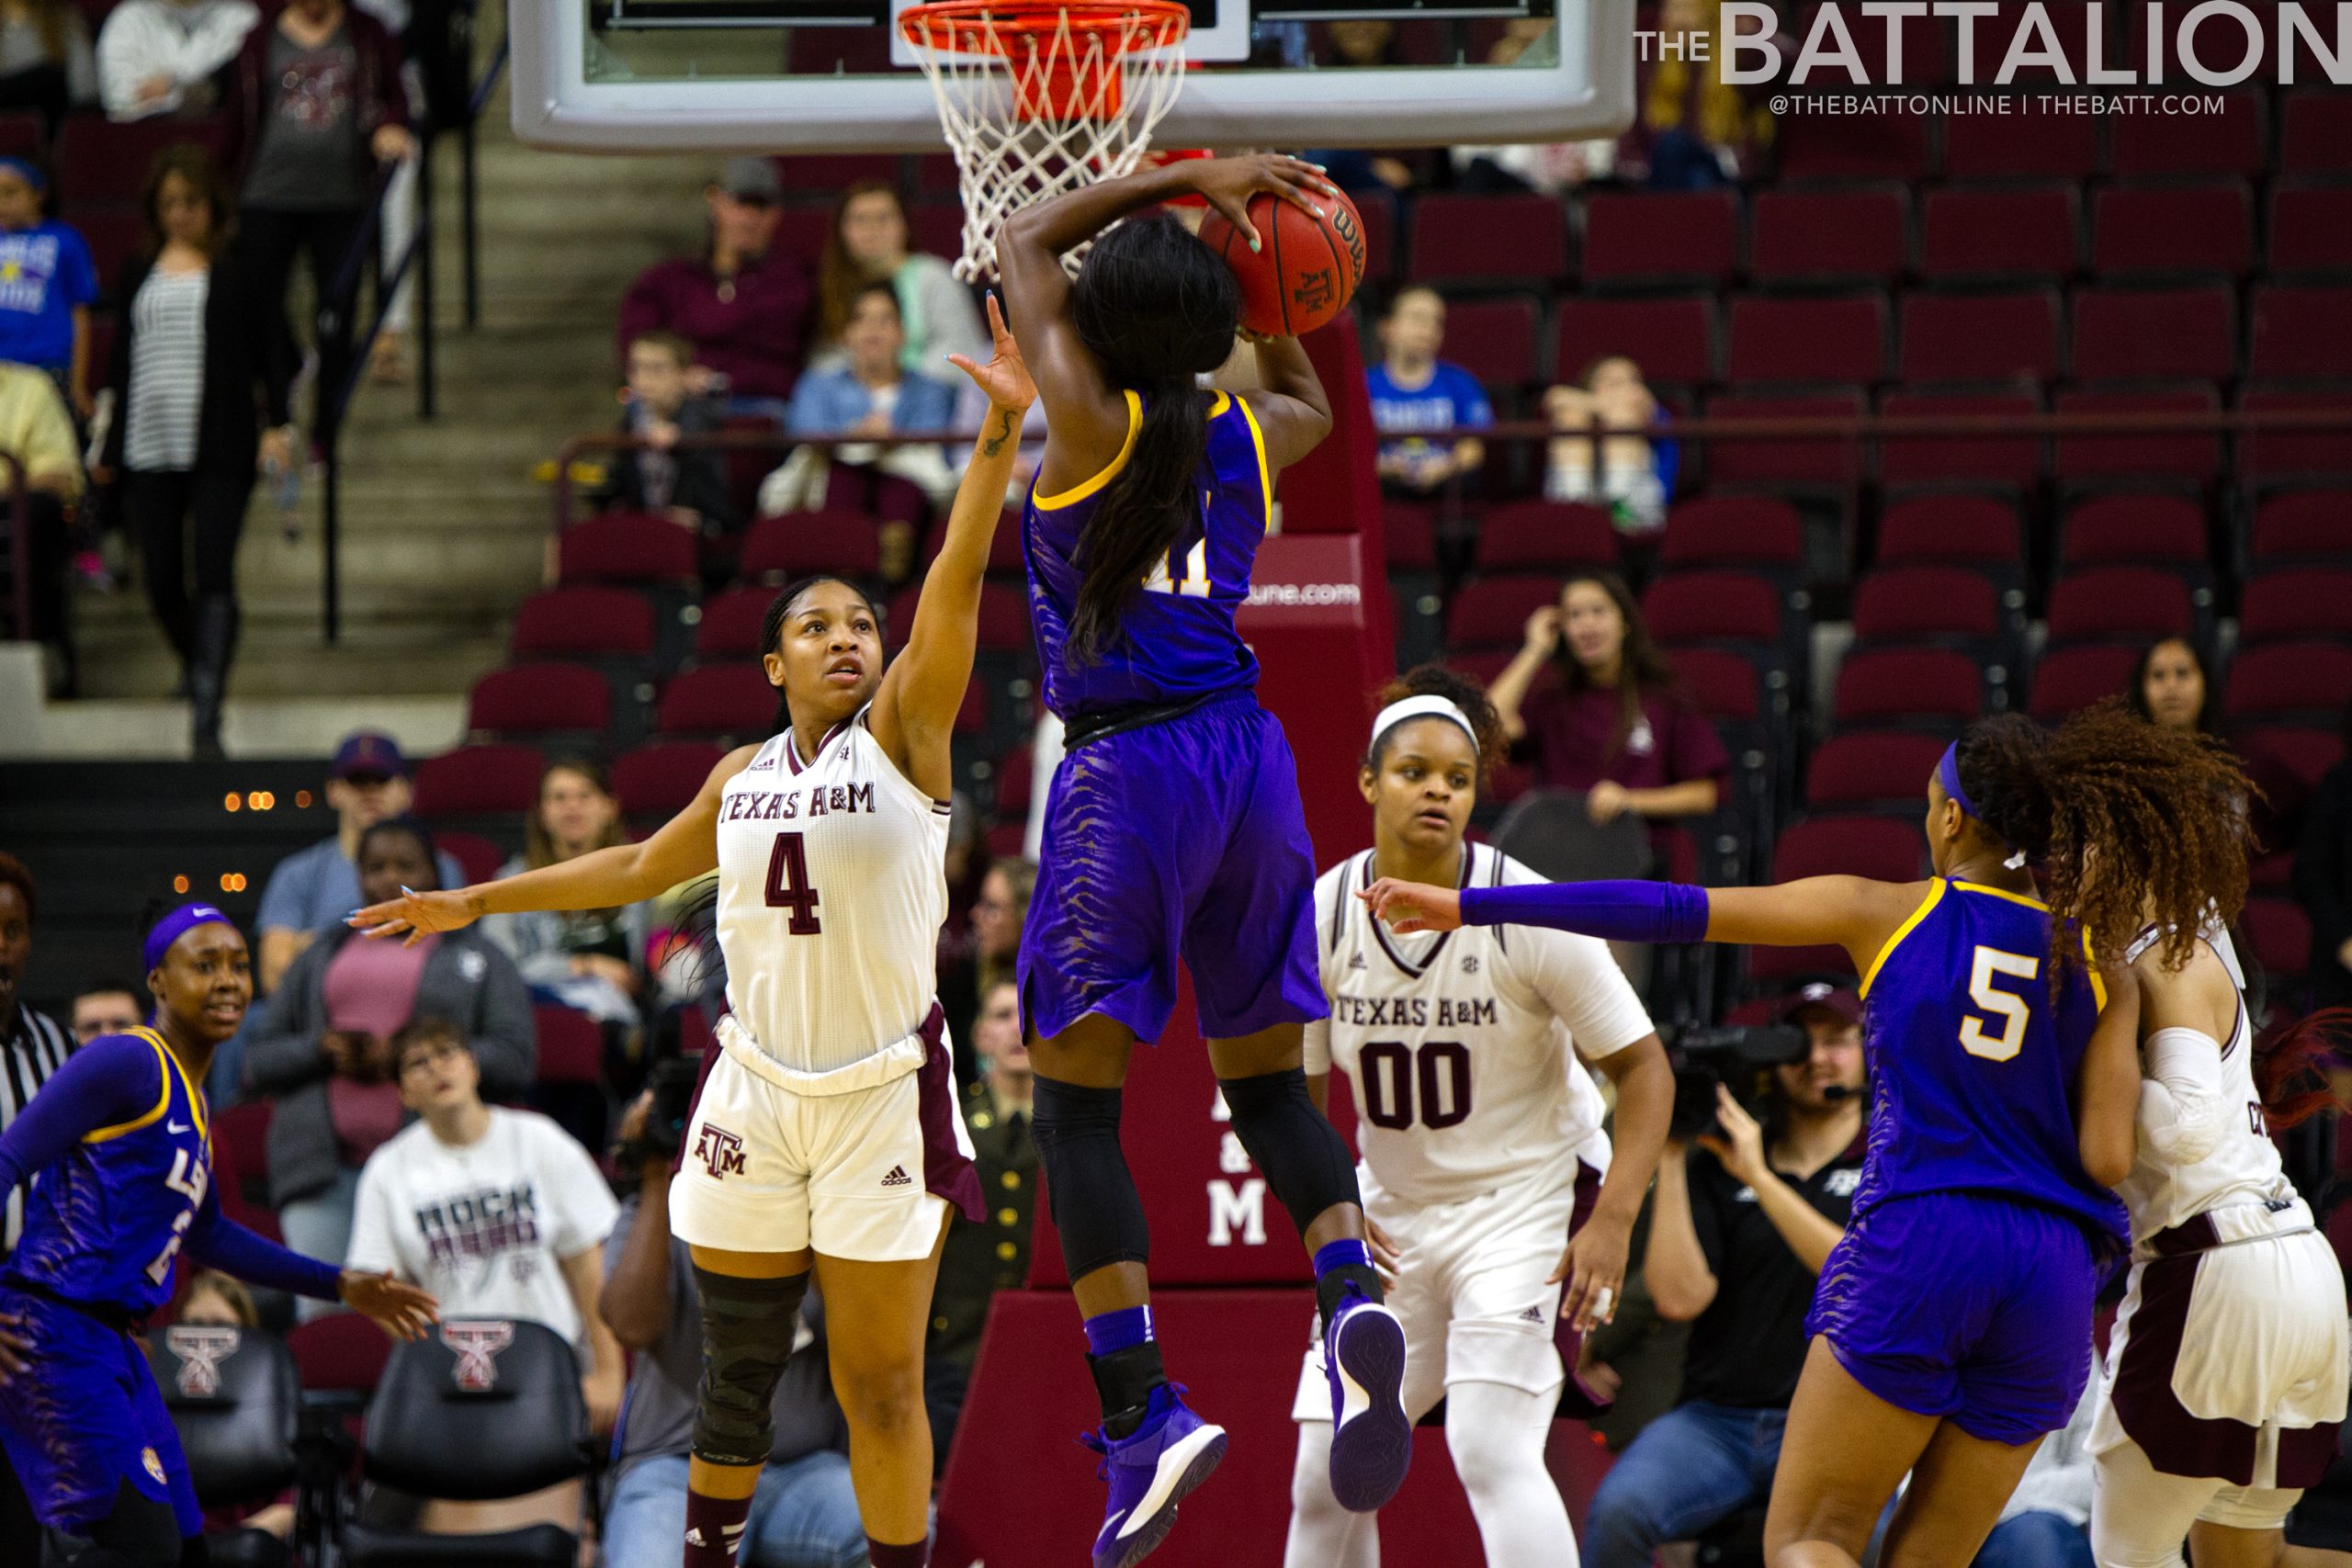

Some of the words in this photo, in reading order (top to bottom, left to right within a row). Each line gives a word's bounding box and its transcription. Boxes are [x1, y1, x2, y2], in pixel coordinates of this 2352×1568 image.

[720, 789, 801, 824] TEXAS
[808, 781, 876, 818] A&M
[764, 832, 821, 935] 4
[1338, 995, 1428, 1027] TEXAS
[1437, 997, 1498, 1027] A&M
[1958, 944, 2040, 1063] 5
[1359, 1042, 1472, 1131] 00
[881, 1177, 912, 1187] adidas
